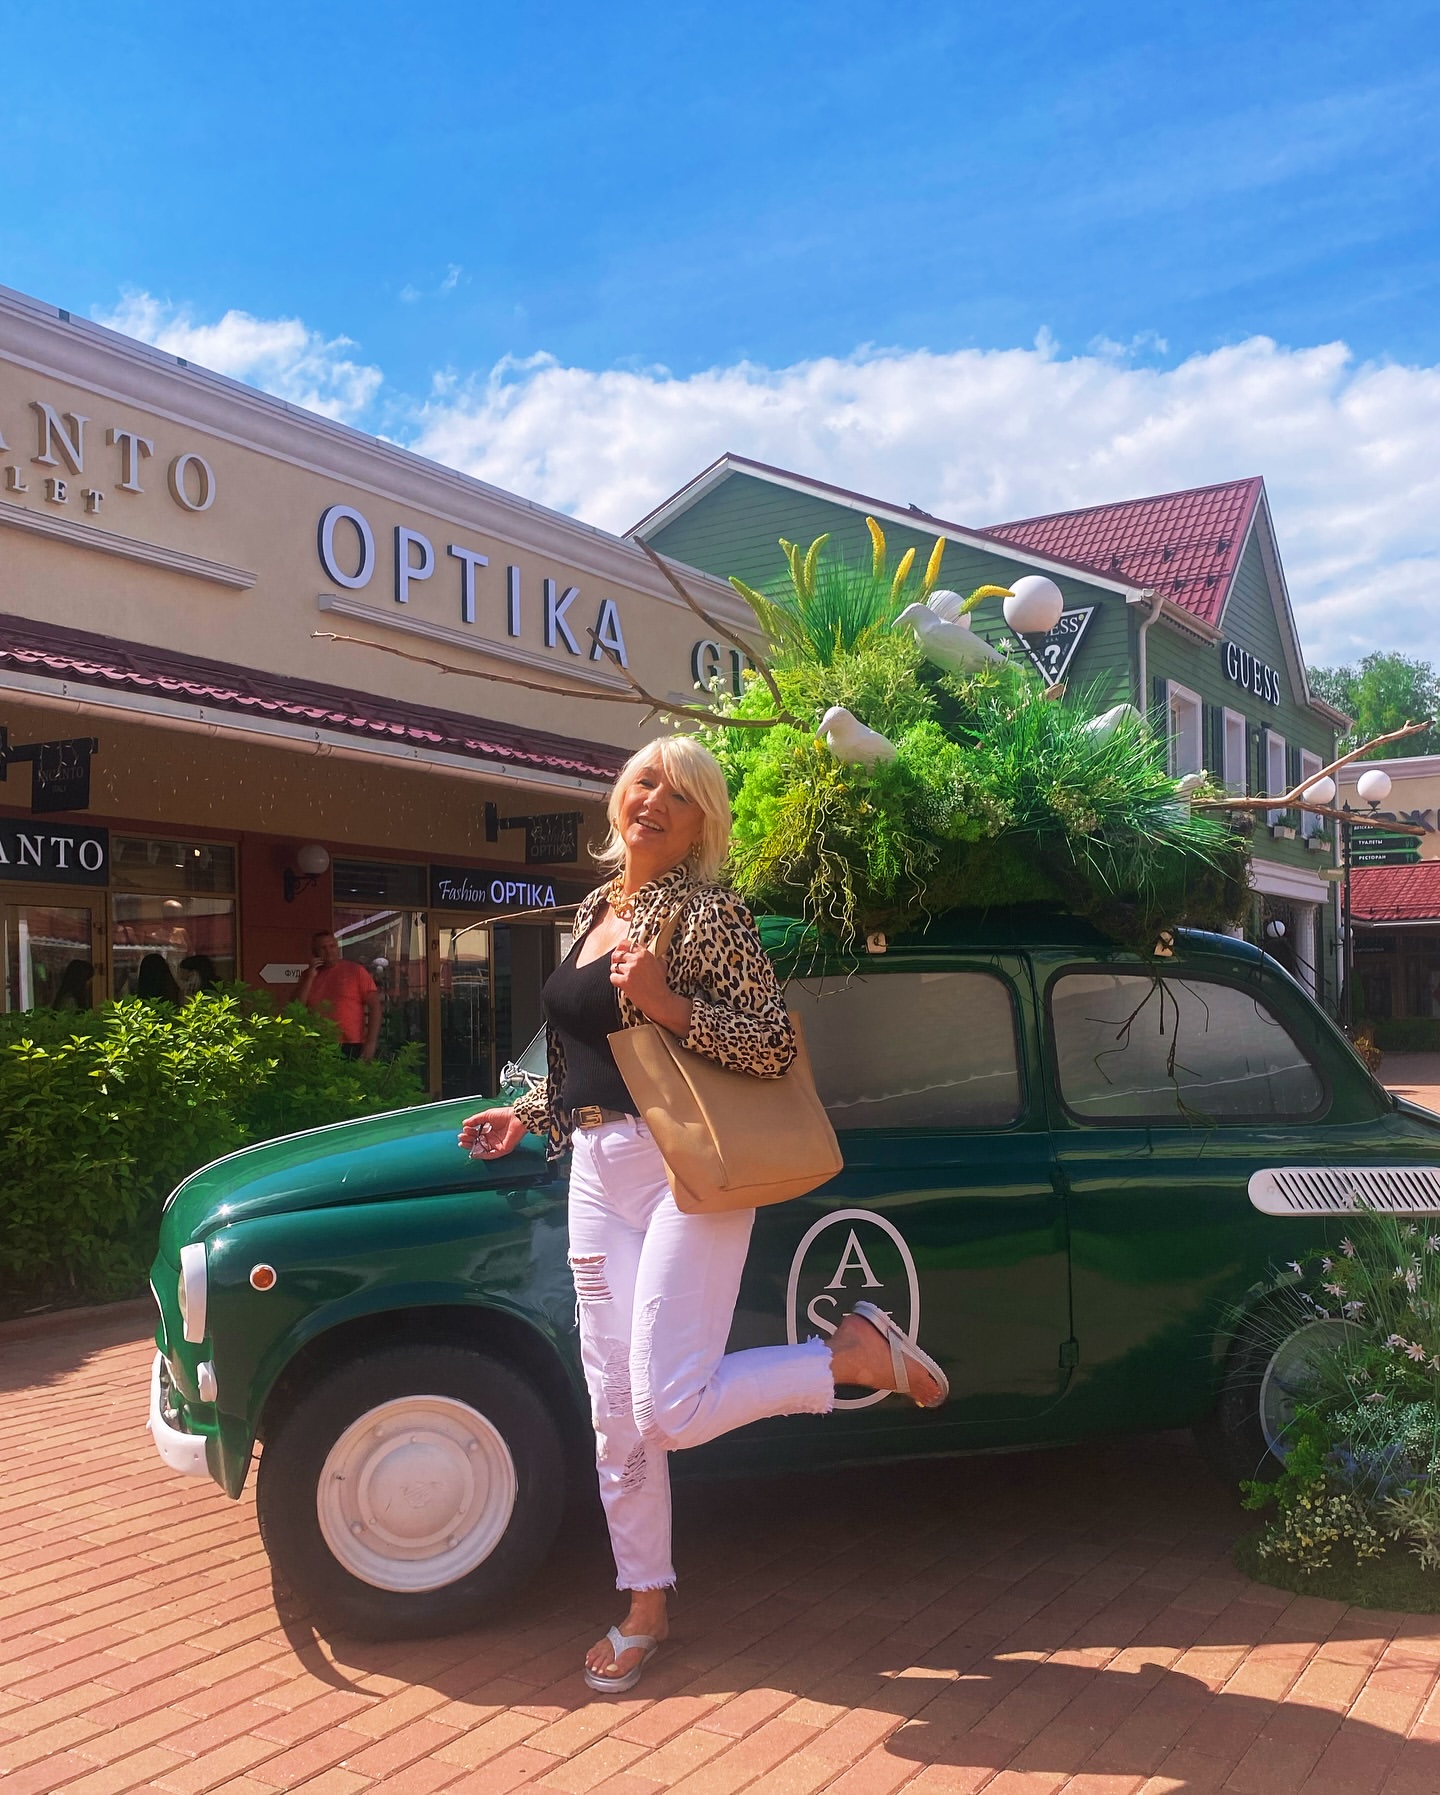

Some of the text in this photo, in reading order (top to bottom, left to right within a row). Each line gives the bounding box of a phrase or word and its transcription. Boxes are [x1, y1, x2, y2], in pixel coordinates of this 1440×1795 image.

[317, 505, 629, 668] OPTIKA
[1224, 641, 1280, 706] GUESS
[438, 877, 557, 907] Fashion OPTIKA
[823, 1228, 885, 1290] A
